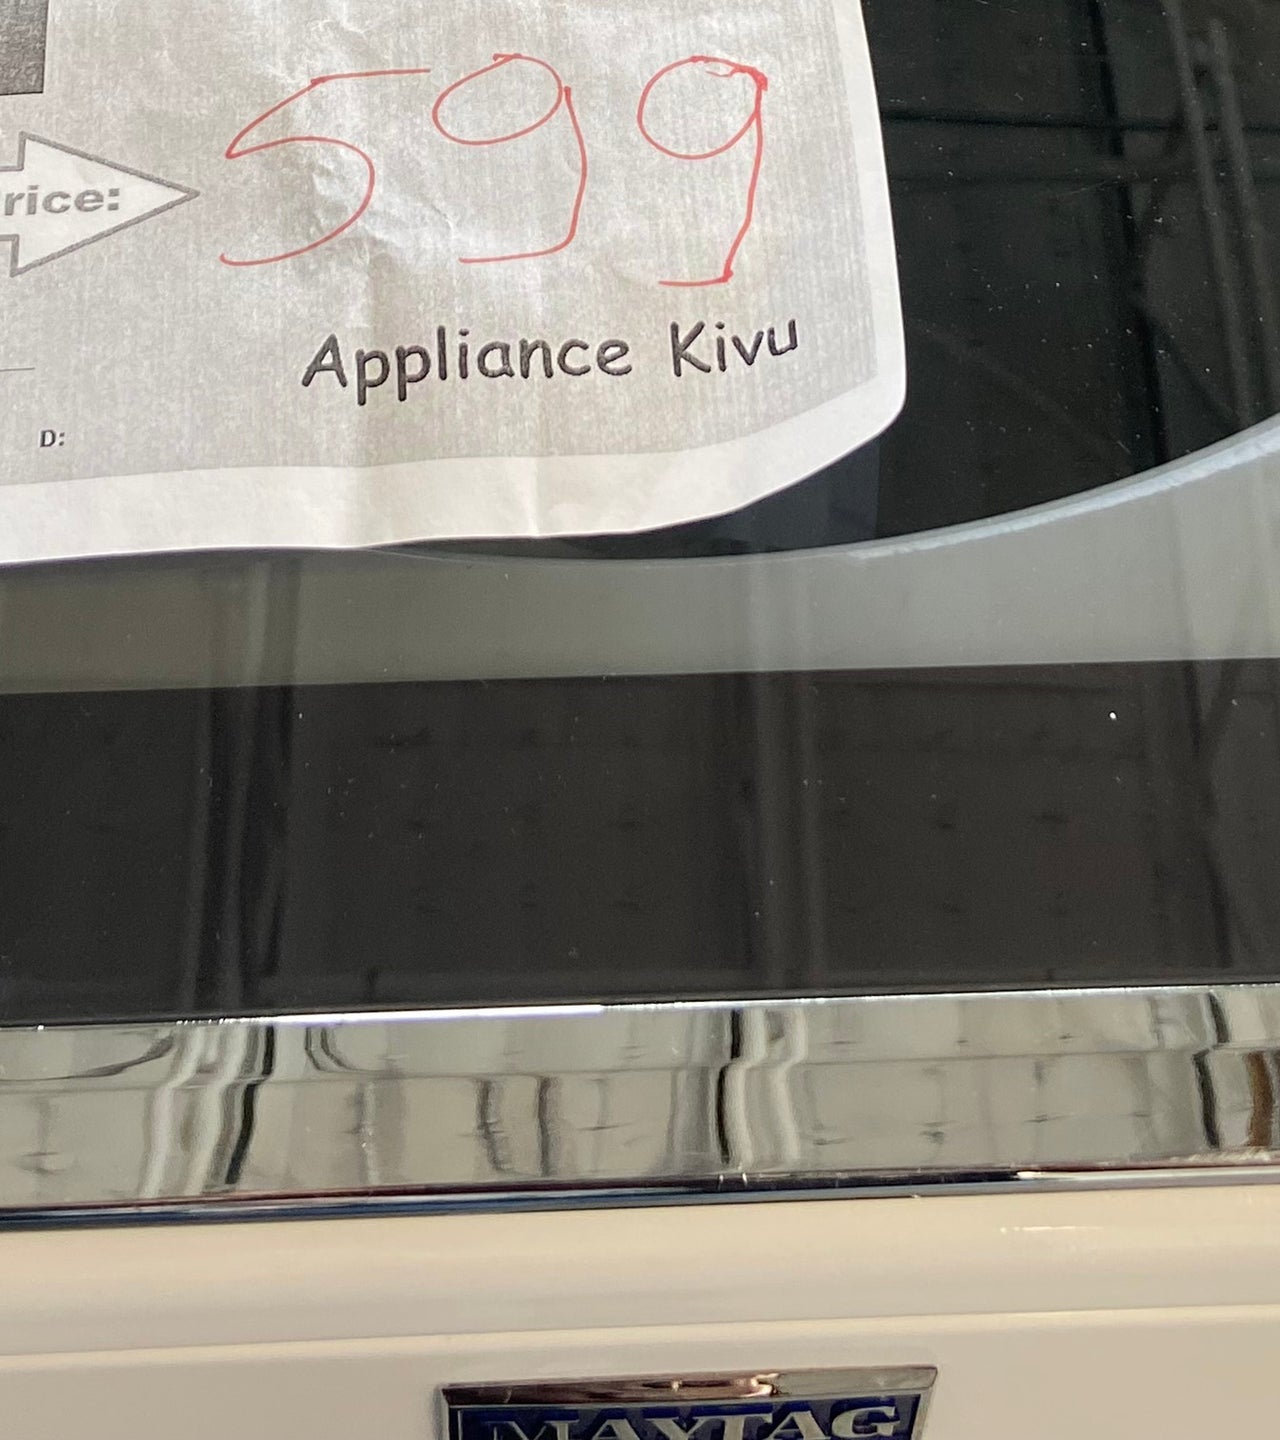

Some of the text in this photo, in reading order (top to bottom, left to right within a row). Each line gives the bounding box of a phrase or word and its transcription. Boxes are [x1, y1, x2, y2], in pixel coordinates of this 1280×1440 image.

[218, 52, 769, 287] 599
[301, 317, 801, 407] Appliance Kivu
[38, 429, 67, 449] D:
